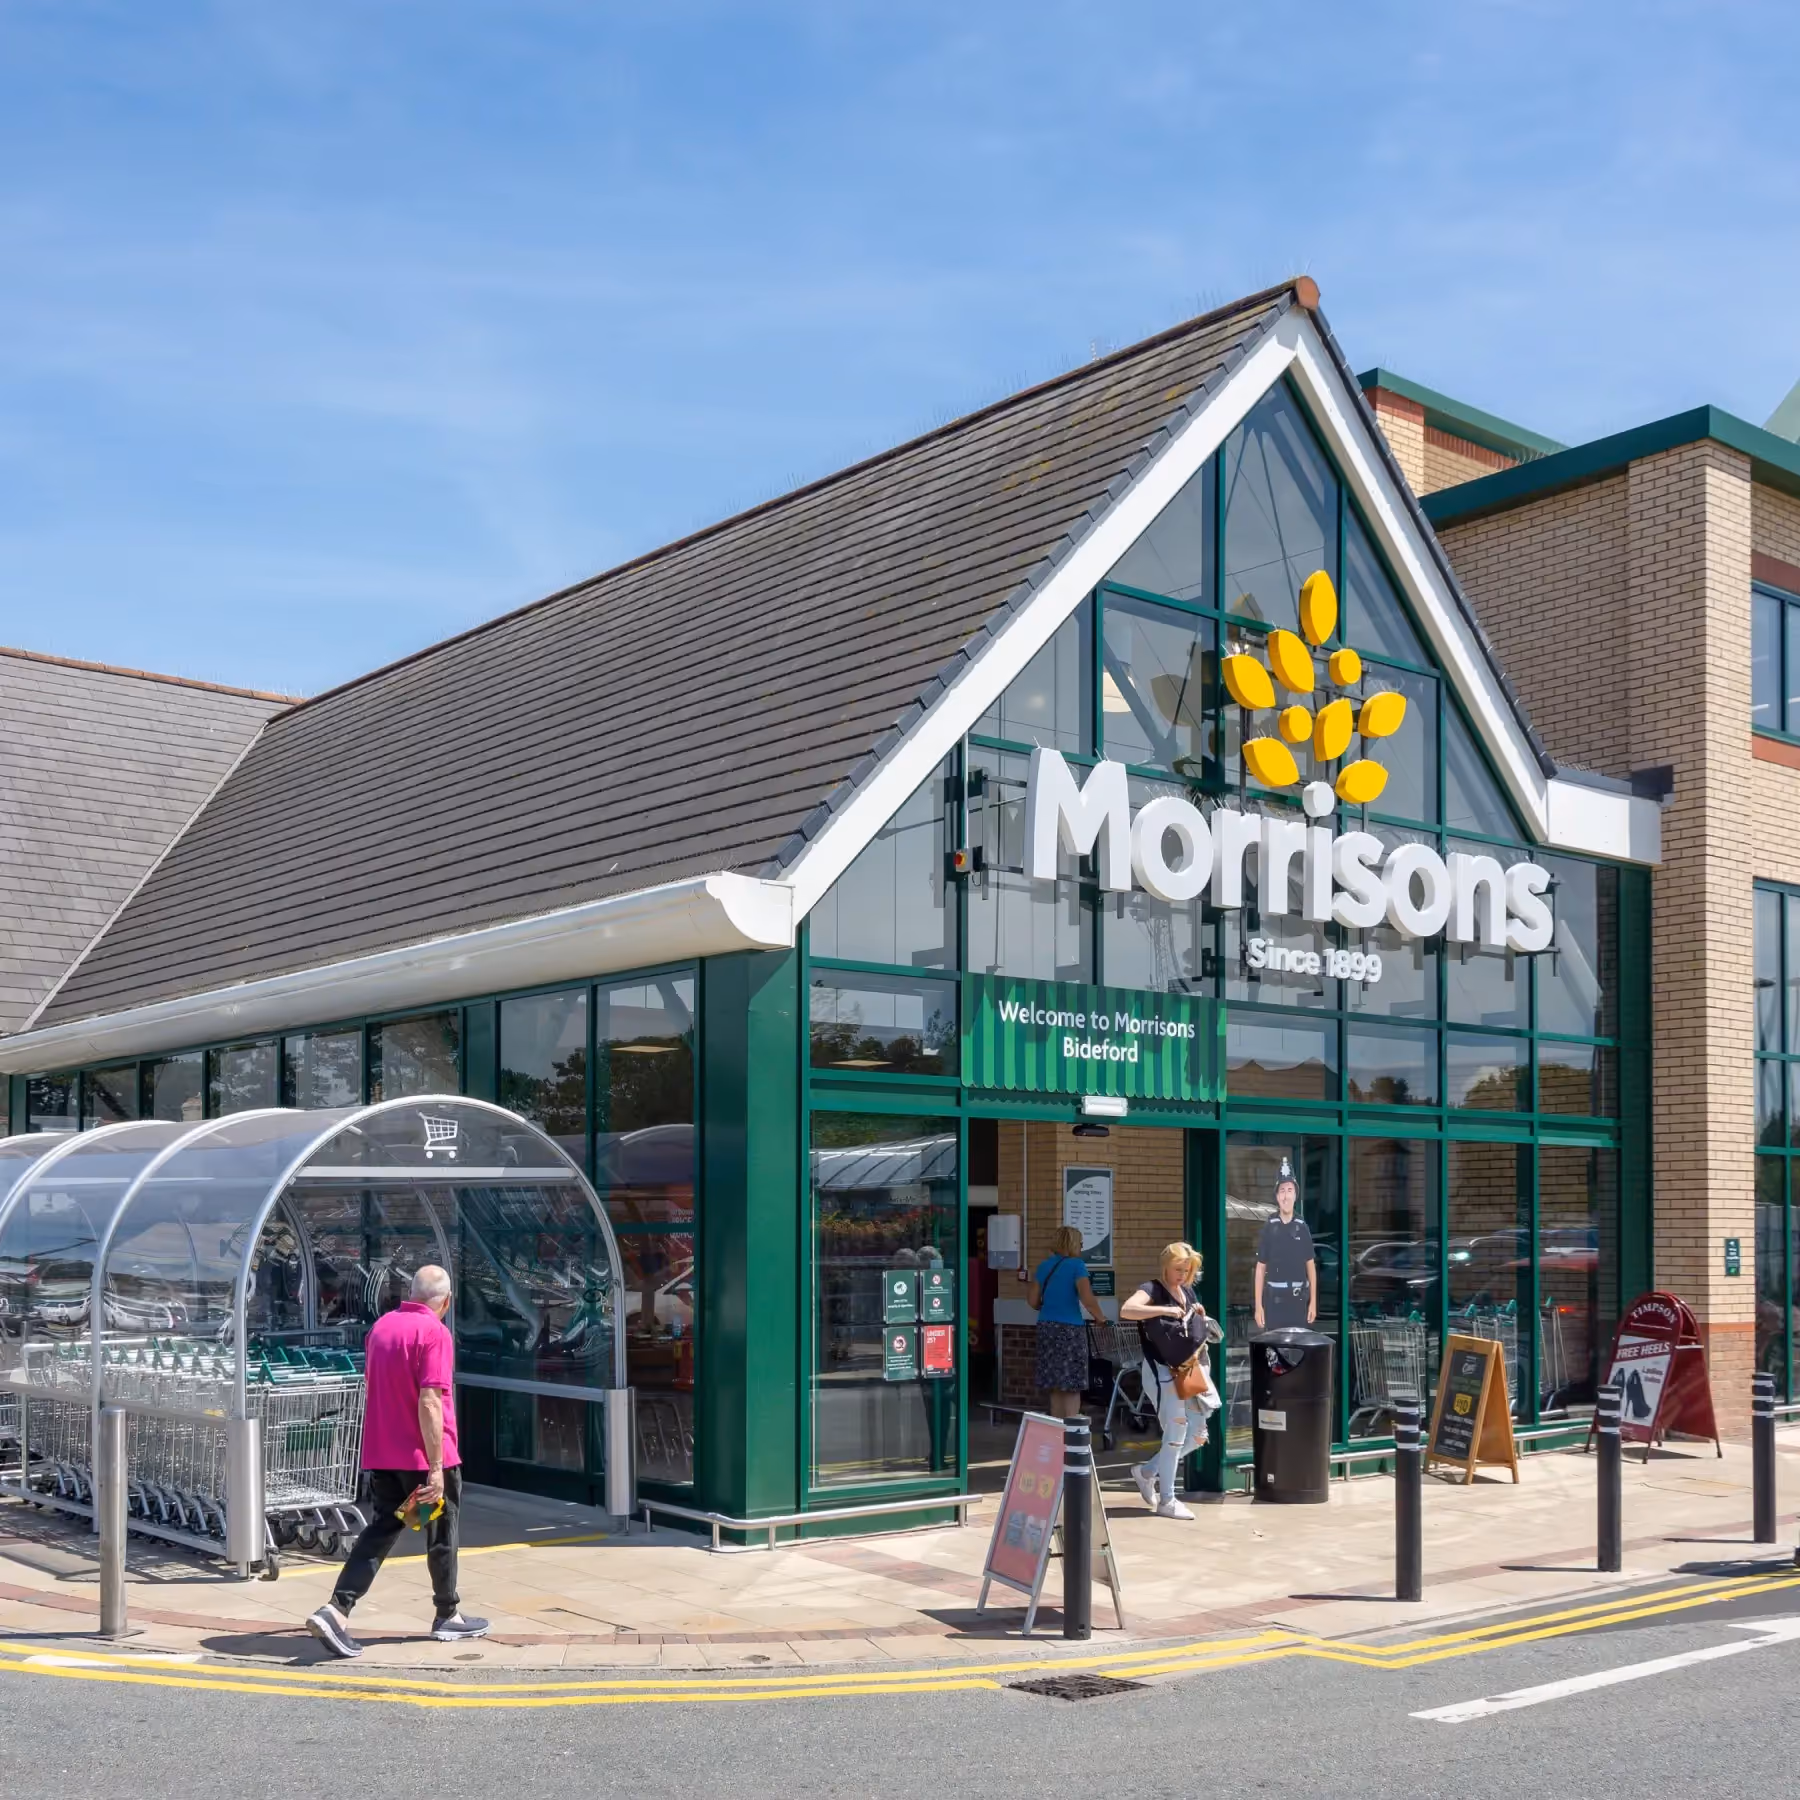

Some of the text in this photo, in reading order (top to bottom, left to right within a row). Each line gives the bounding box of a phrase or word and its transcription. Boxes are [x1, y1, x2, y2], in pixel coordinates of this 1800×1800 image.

[1026, 747, 1554, 952] Morrisons
[1247, 938, 1382, 983] Since 1899
[999, 1000, 1195, 1038] Welcome to Morrisons
[1063, 1036, 1138, 1063] Bideford
[1631, 1302, 1677, 1325] TIMPSON
[1616, 1342, 1671, 1360] FREE HEELS
